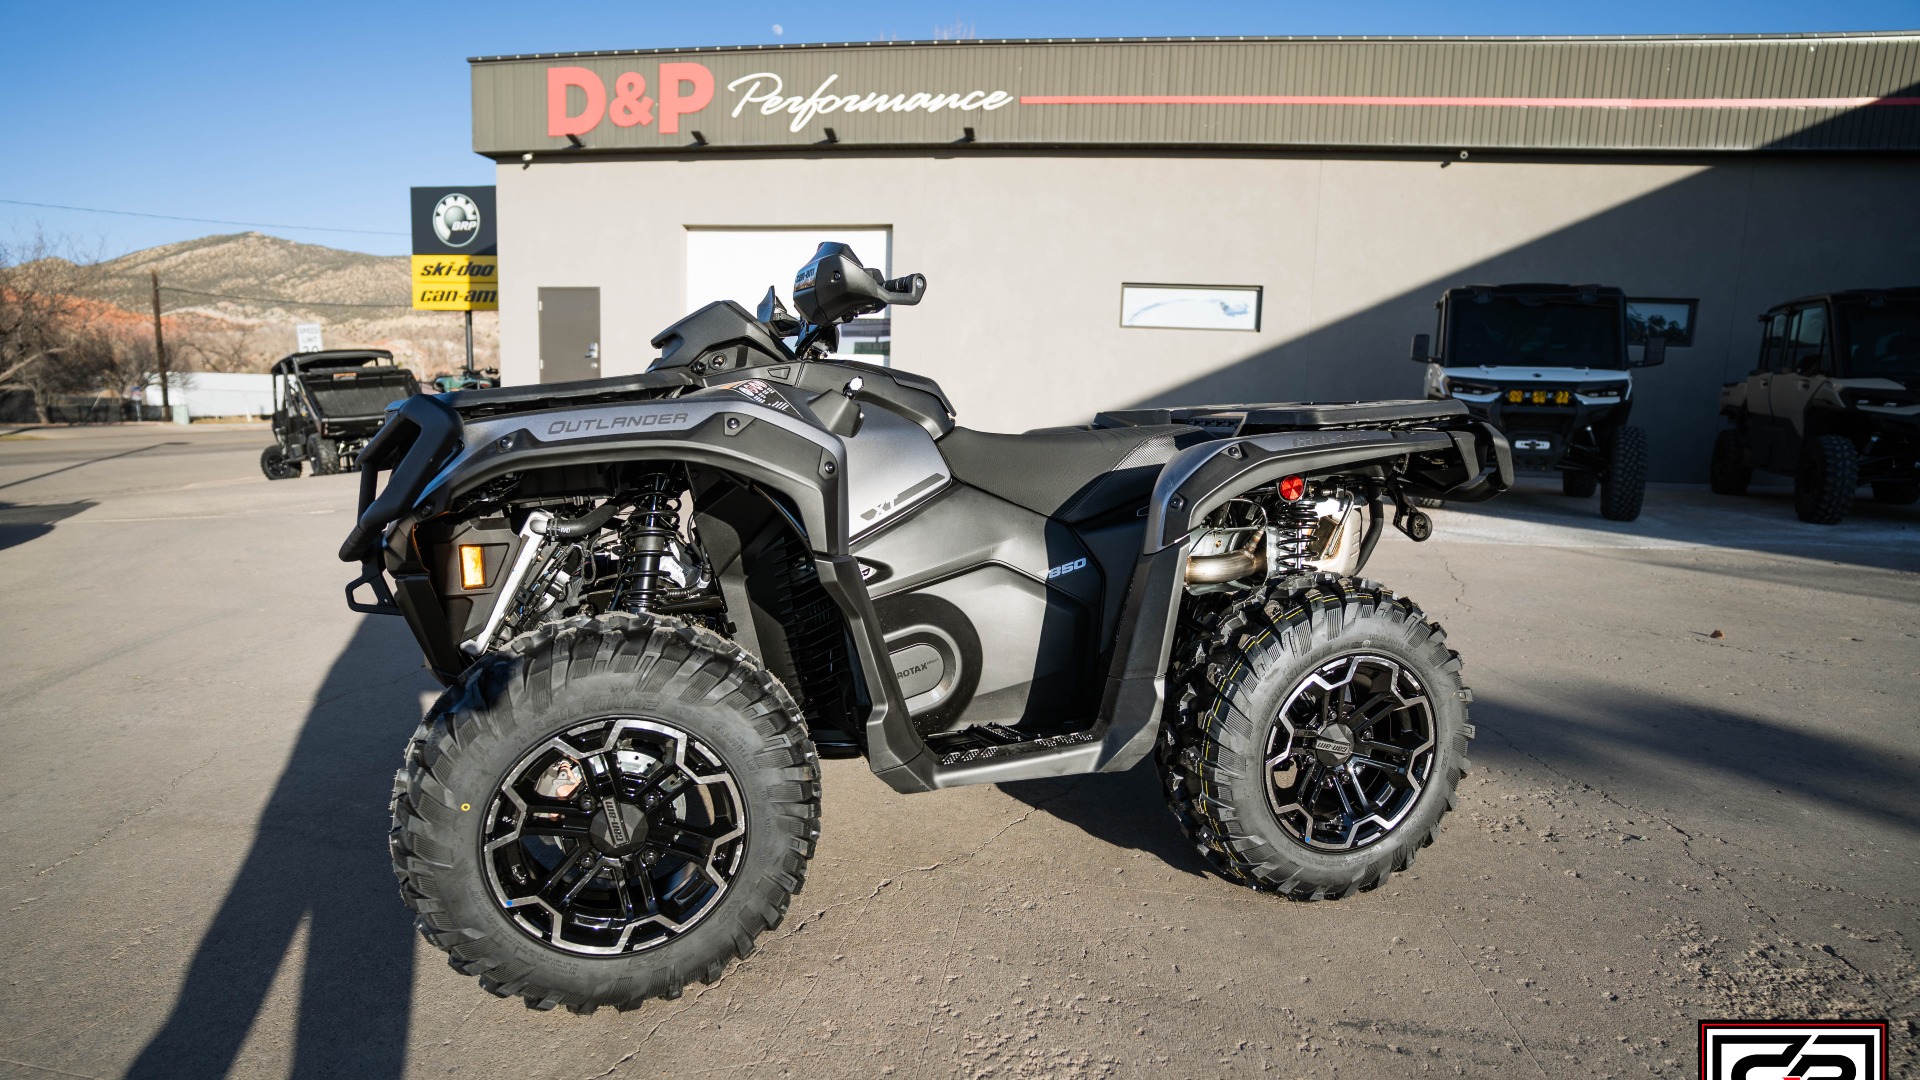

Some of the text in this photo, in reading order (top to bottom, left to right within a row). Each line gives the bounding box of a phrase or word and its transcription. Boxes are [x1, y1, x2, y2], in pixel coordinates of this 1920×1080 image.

[547, 62, 1014, 136] D&P Performance
[451, 220, 478, 231] BRP
[420, 261, 495, 277] ski-doo
[420, 289, 497, 303] can-am
[548, 413, 688, 435] OUTLANDER
[1048, 557, 1087, 579] 850
[896, 662, 928, 679] ROTAX
[1316, 742, 1348, 753] can-am
[605, 801, 624, 841] can-am
